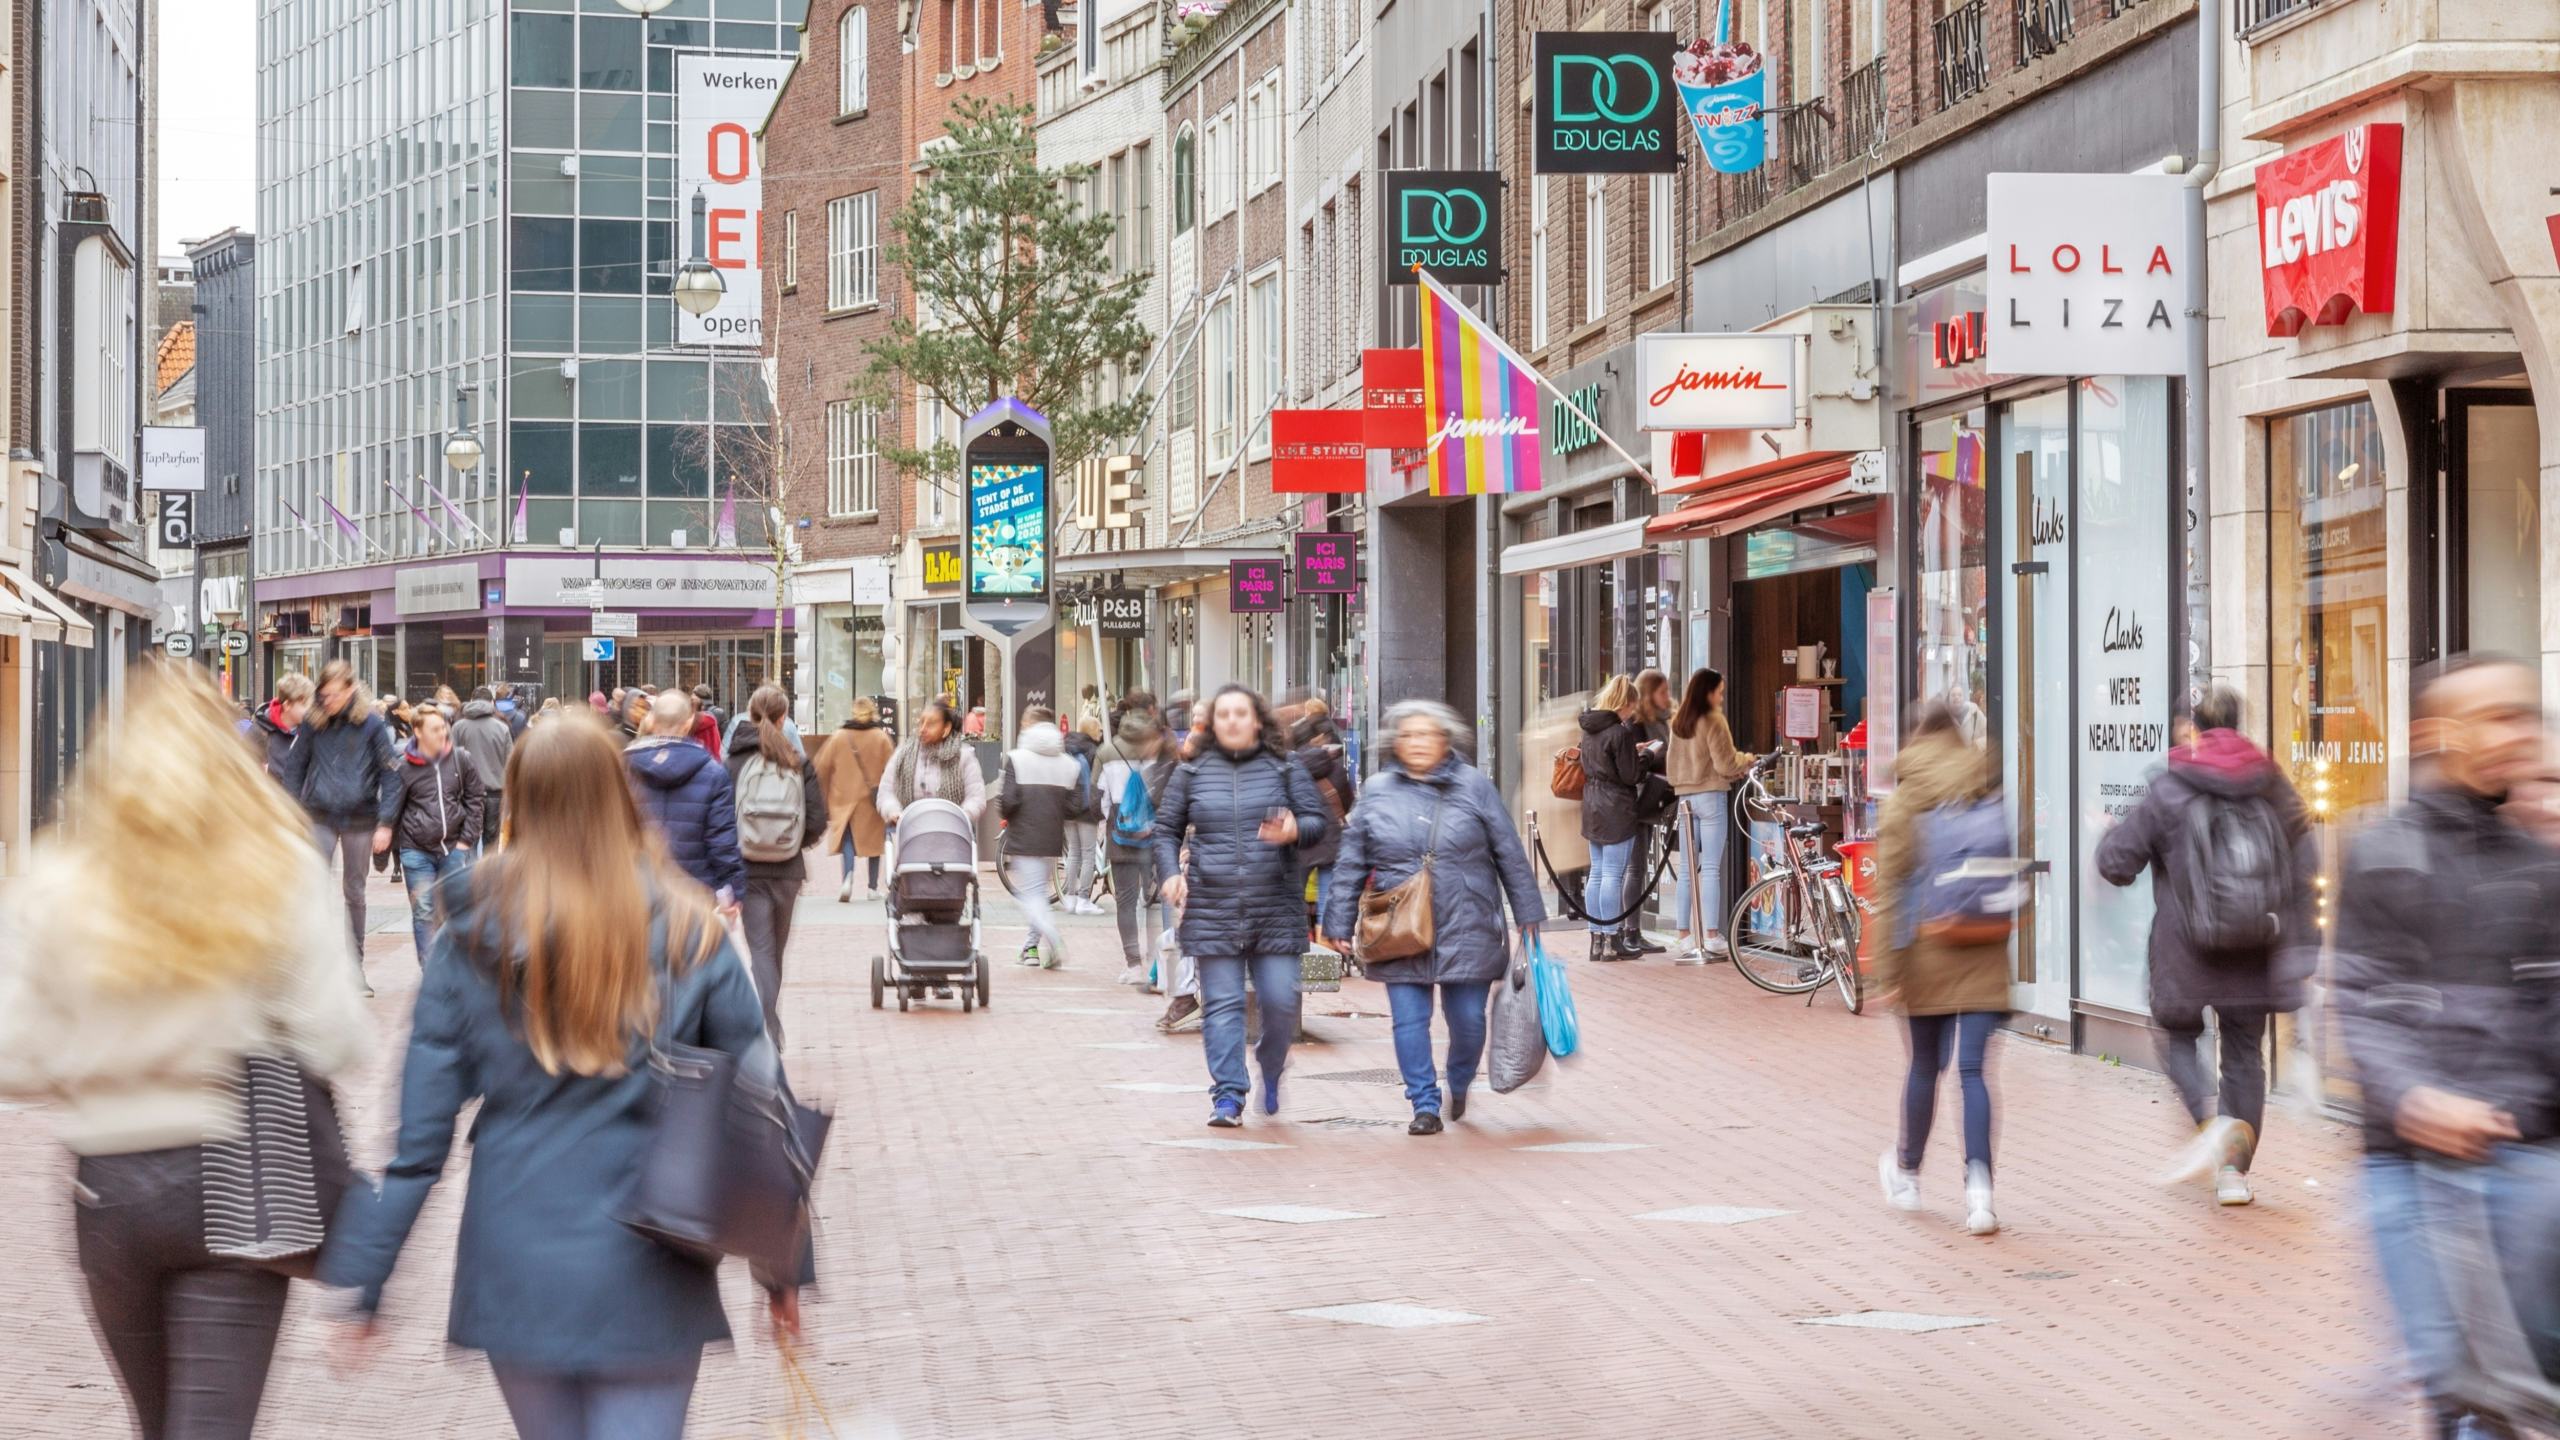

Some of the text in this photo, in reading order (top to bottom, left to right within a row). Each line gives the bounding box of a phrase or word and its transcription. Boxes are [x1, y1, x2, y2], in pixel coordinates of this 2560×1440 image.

[703, 71, 778, 90] Werken
[1554, 129, 1660, 151] DOUGLAS
[709, 209, 762, 269] E
[1401, 249, 1488, 268] DOUGLAS
[2010, 243, 2172, 274] LOLA
[2010, 298, 2172, 328] LIZA
[1650, 363, 1787, 407] jamin
[1552, 382, 1599, 455] DOUGLAS
[1427, 411, 1539, 453] jamin
[1312, 446, 1360, 455] STING
[976, 484, 1024, 506] TENT OP DE
[2032, 495, 2064, 546] larks
[1315, 542, 1336, 555] ICI
[1306, 557, 1346, 569] PARIS
[1248, 568, 1265, 579] ICI
[1317, 572, 1336, 584] XL
[656, 578, 676, 590] OF
[680, 578, 767, 591] INNOVATION
[1240, 581, 1274, 592] PARIS
[1103, 599, 1142, 617] P&B
[1249, 593, 1265, 604] XL
[1103, 621, 1141, 629] PULL&BEAR
[2104, 605, 2143, 653] Clarks
[168, 641, 192, 650] ONLY
[2109, 677, 2141, 706] WE'RE
[2089, 723, 2163, 752] NEARLY READY
[2292, 741, 2384, 764] BALLOON JEANS
